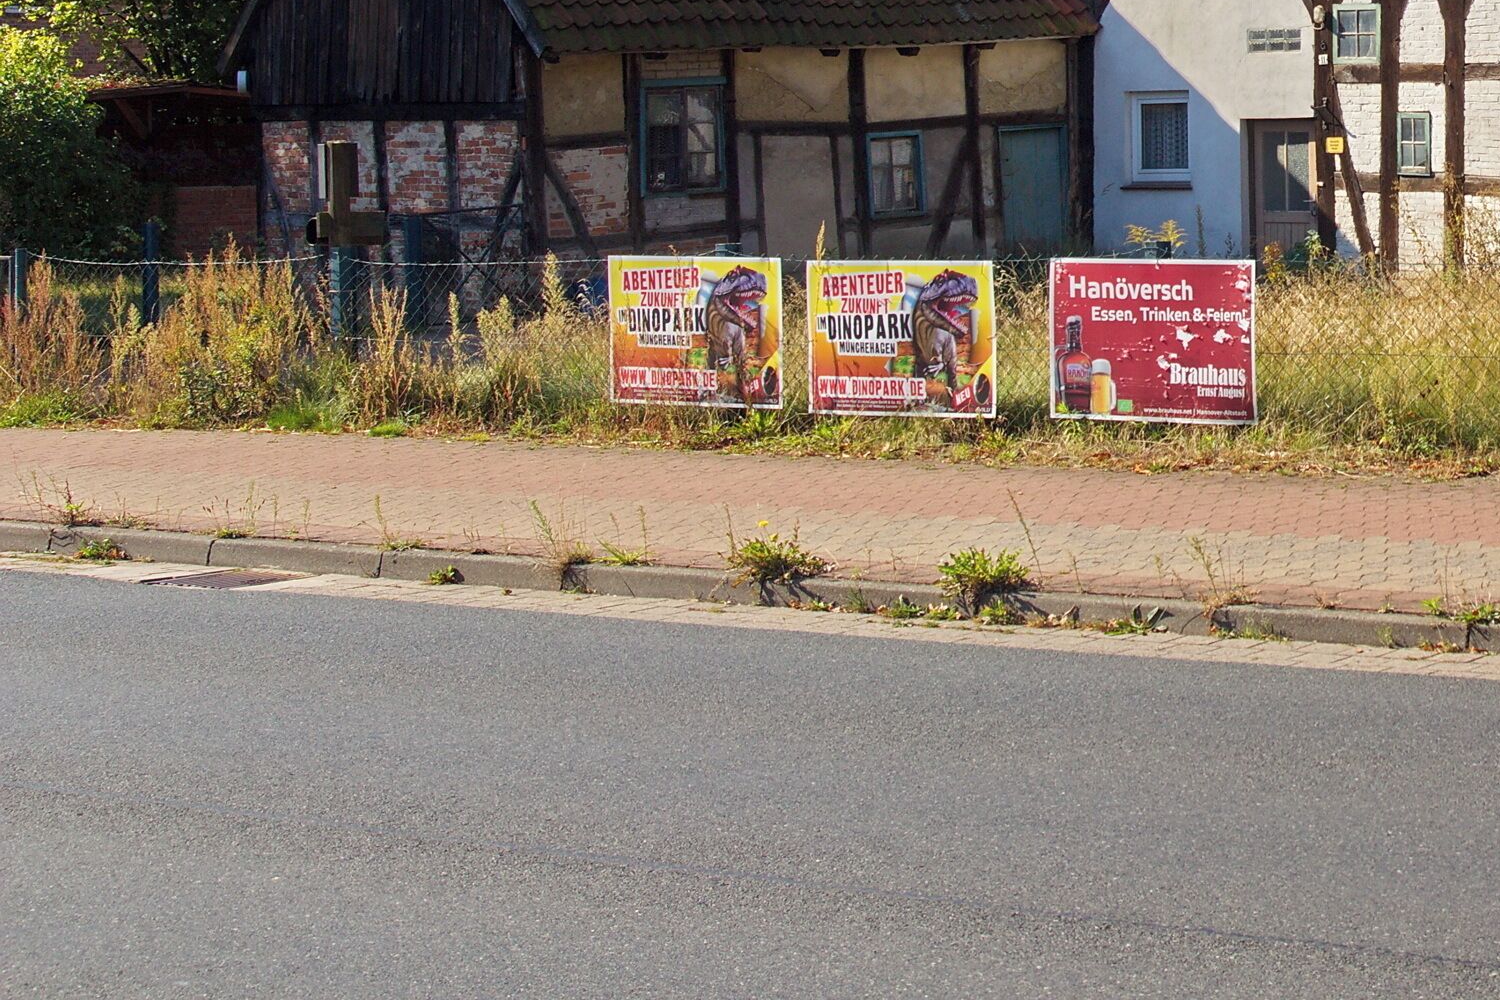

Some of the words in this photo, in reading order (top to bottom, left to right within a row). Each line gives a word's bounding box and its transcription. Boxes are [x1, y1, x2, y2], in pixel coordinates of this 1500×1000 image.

[623, 267, 699, 291] ABENTEUER
[822, 272, 904, 297] ABENTEUER
[1069, 275, 1194, 301] Hanöversch
[640, 292, 686, 307] ZUKUNFT
[841, 297, 889, 314] ZUKUNFT
[629, 307, 706, 332] DINOPARK
[817, 317, 827, 330] IM
[828, 313, 912, 340] DINOPARK
[1091, 306, 1137, 324] Essen,
[1140, 307, 1190, 322] Trinken
[1193, 308, 1204, 322] &
[1206, 307, 1246, 322] Feiern!
[1170, 362, 1246, 387] Brauhaus
[955, 386, 971, 405] NEU
[1197, 386, 1218, 397] Ernst
[1218, 386, 1245, 399] August
